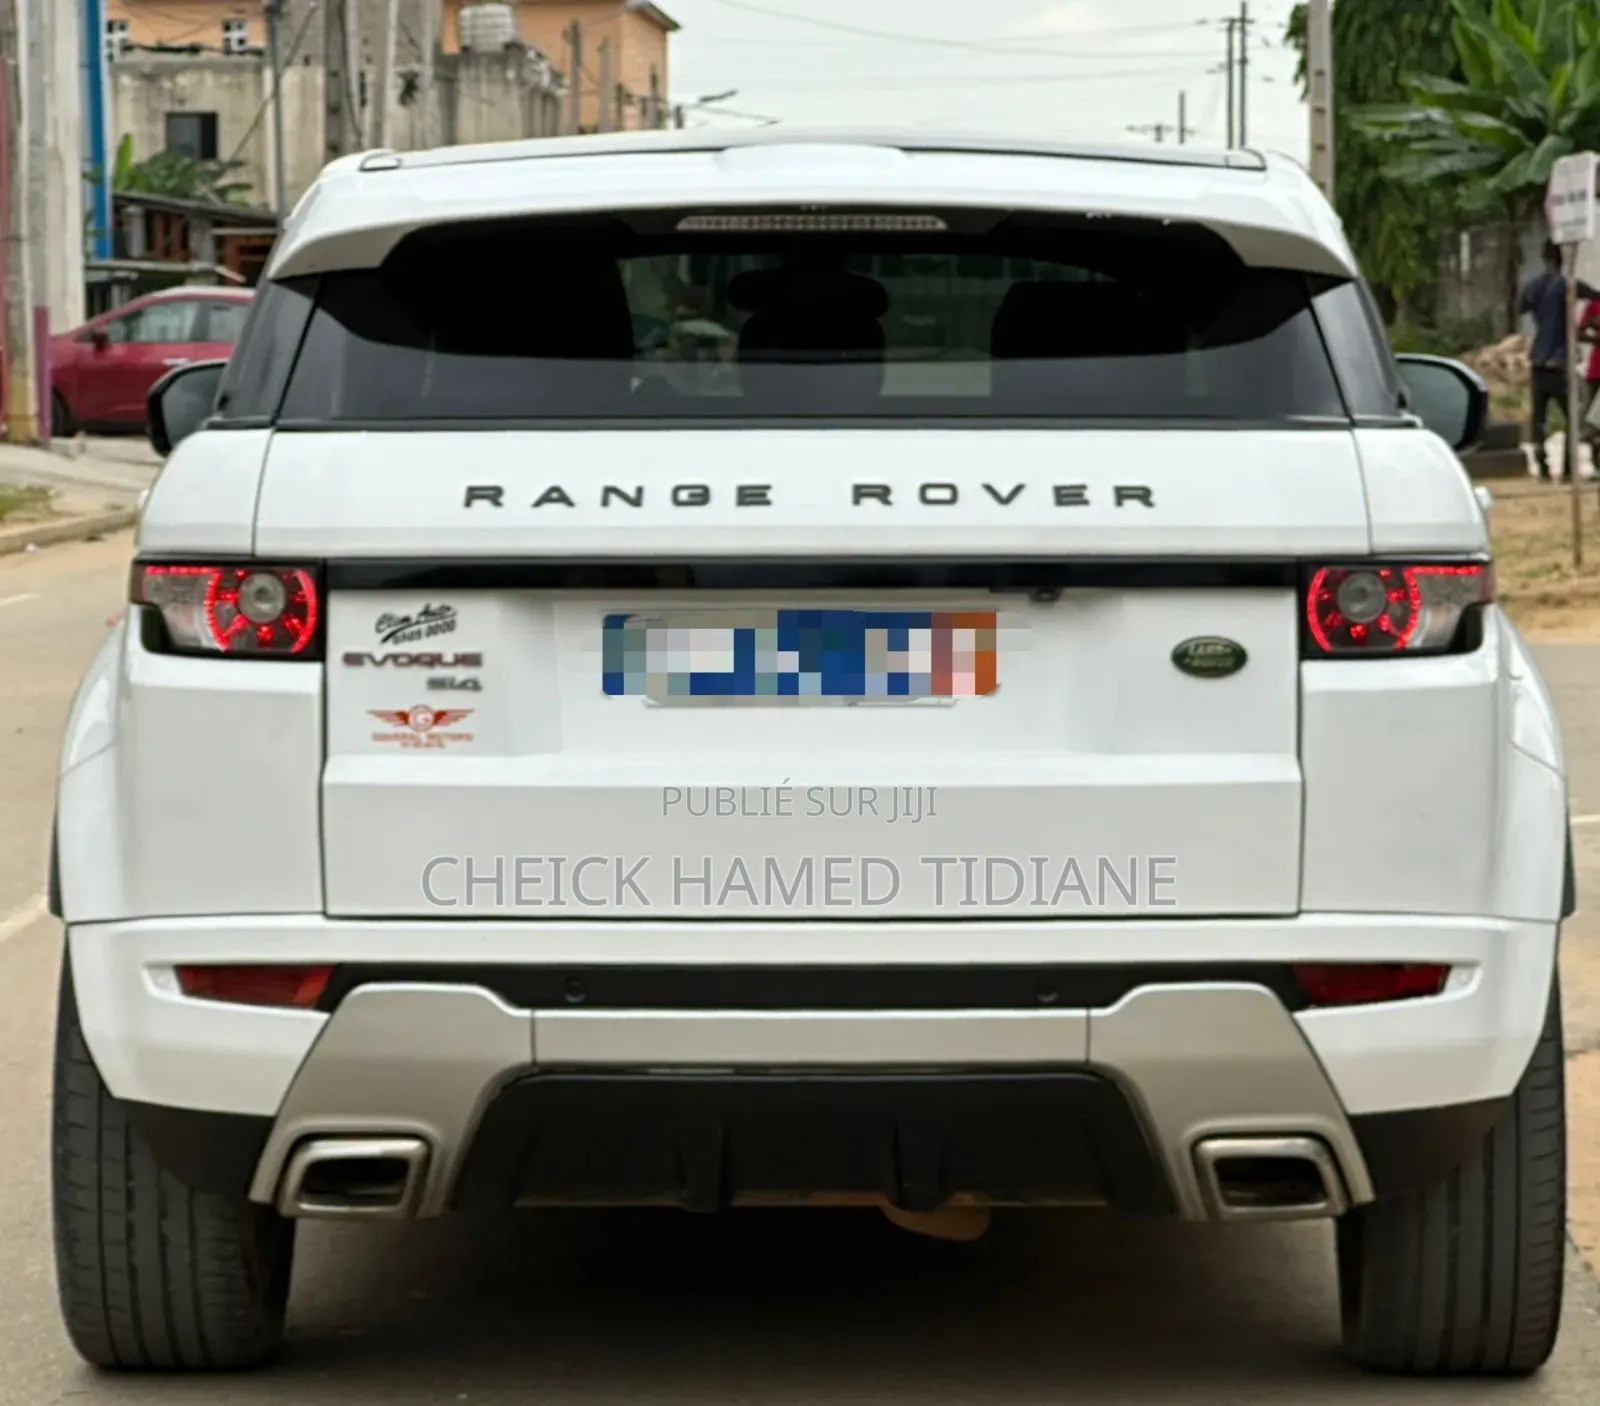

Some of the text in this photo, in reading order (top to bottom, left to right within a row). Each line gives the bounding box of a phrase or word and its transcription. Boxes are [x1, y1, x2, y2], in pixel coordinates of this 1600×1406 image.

[463, 482, 1156, 508] RANGE ROVER
[341, 651, 484, 668] EVOQUE
